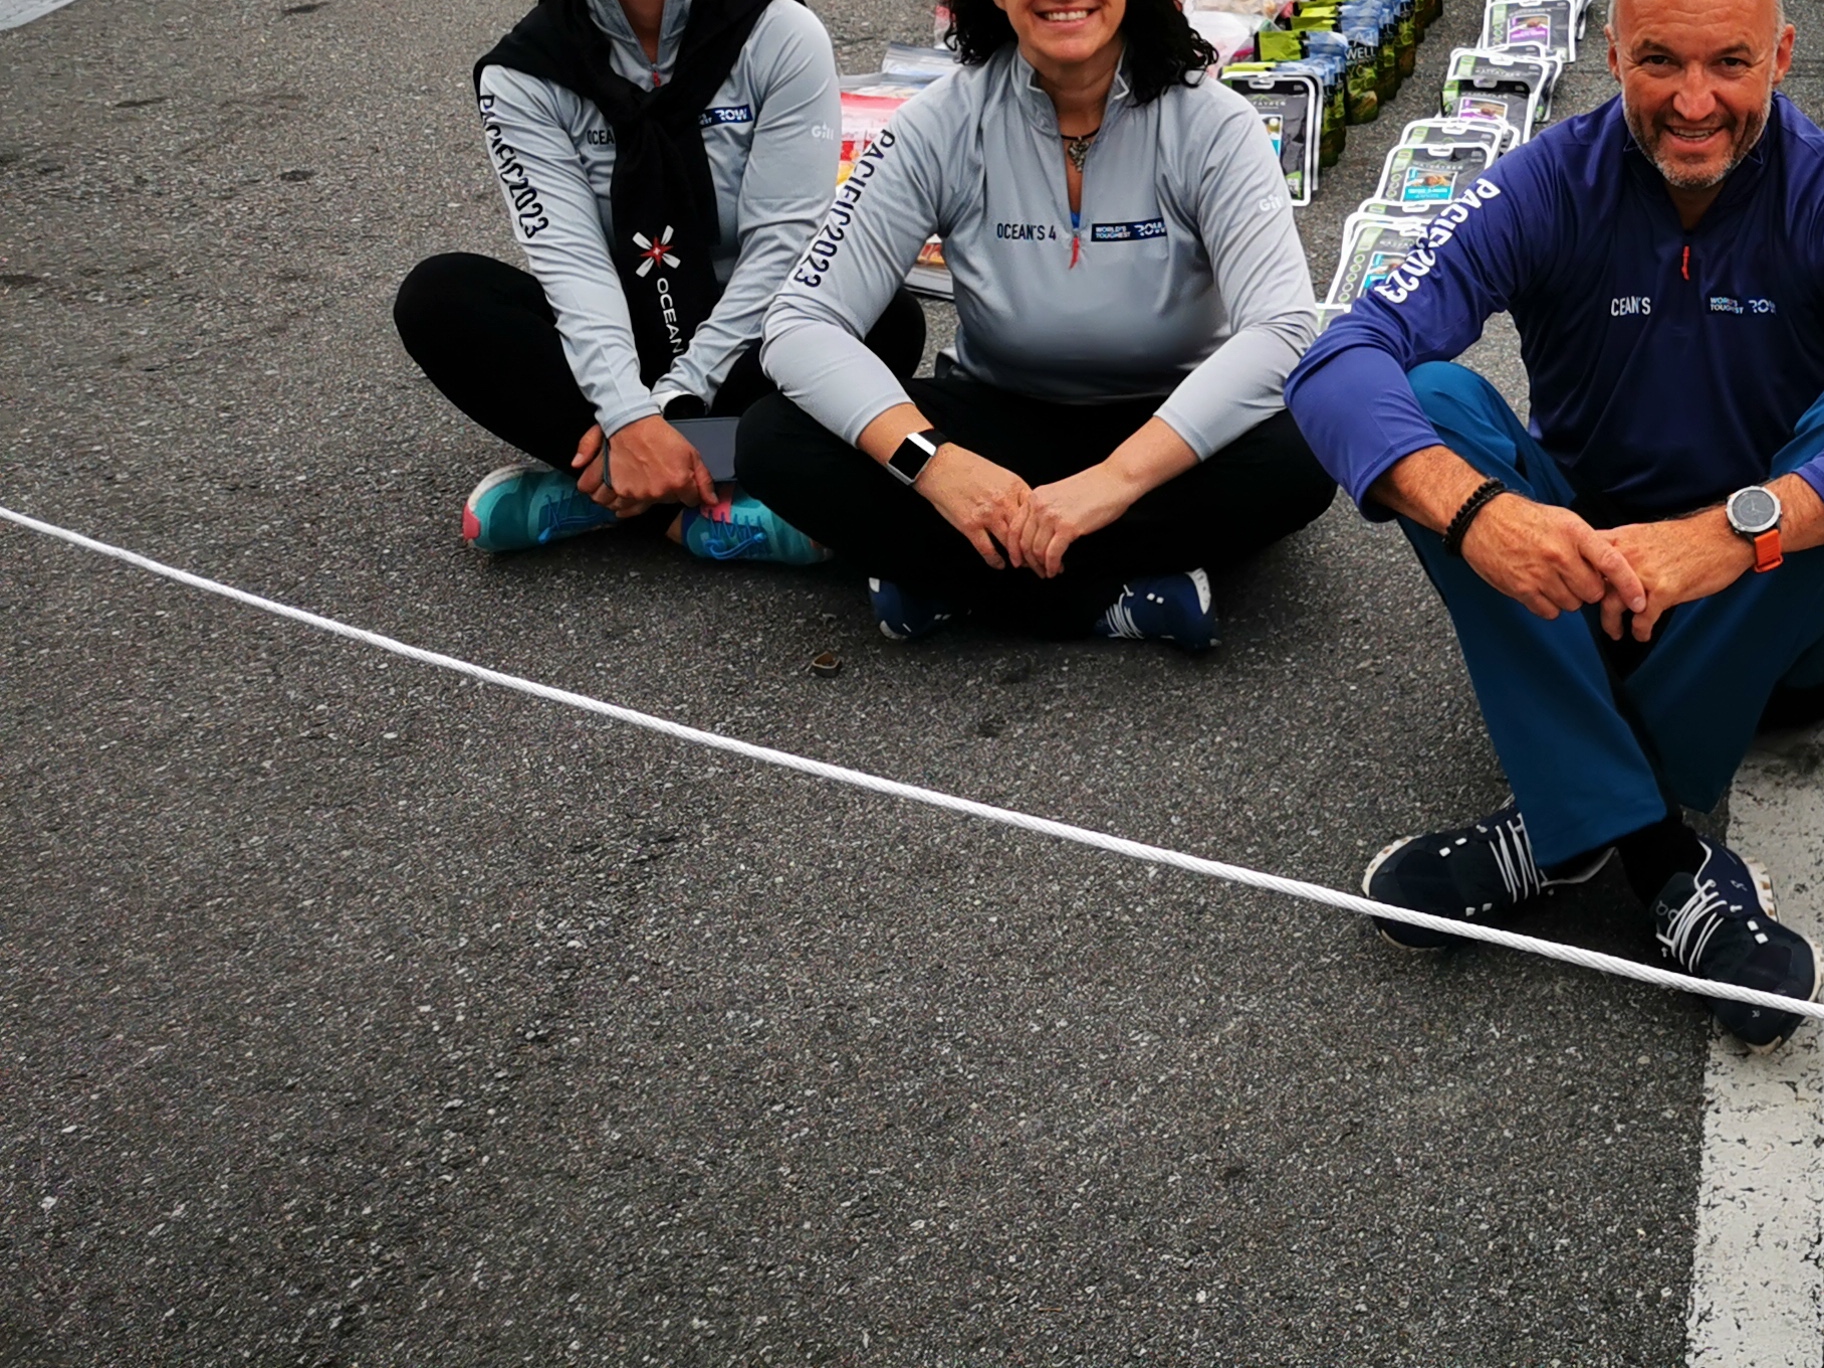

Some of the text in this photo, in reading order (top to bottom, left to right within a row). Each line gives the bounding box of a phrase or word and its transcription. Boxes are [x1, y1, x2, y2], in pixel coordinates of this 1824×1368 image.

[811, 122, 835, 140] Gill
[996, 222, 1057, 240] OCEAN'S 4
